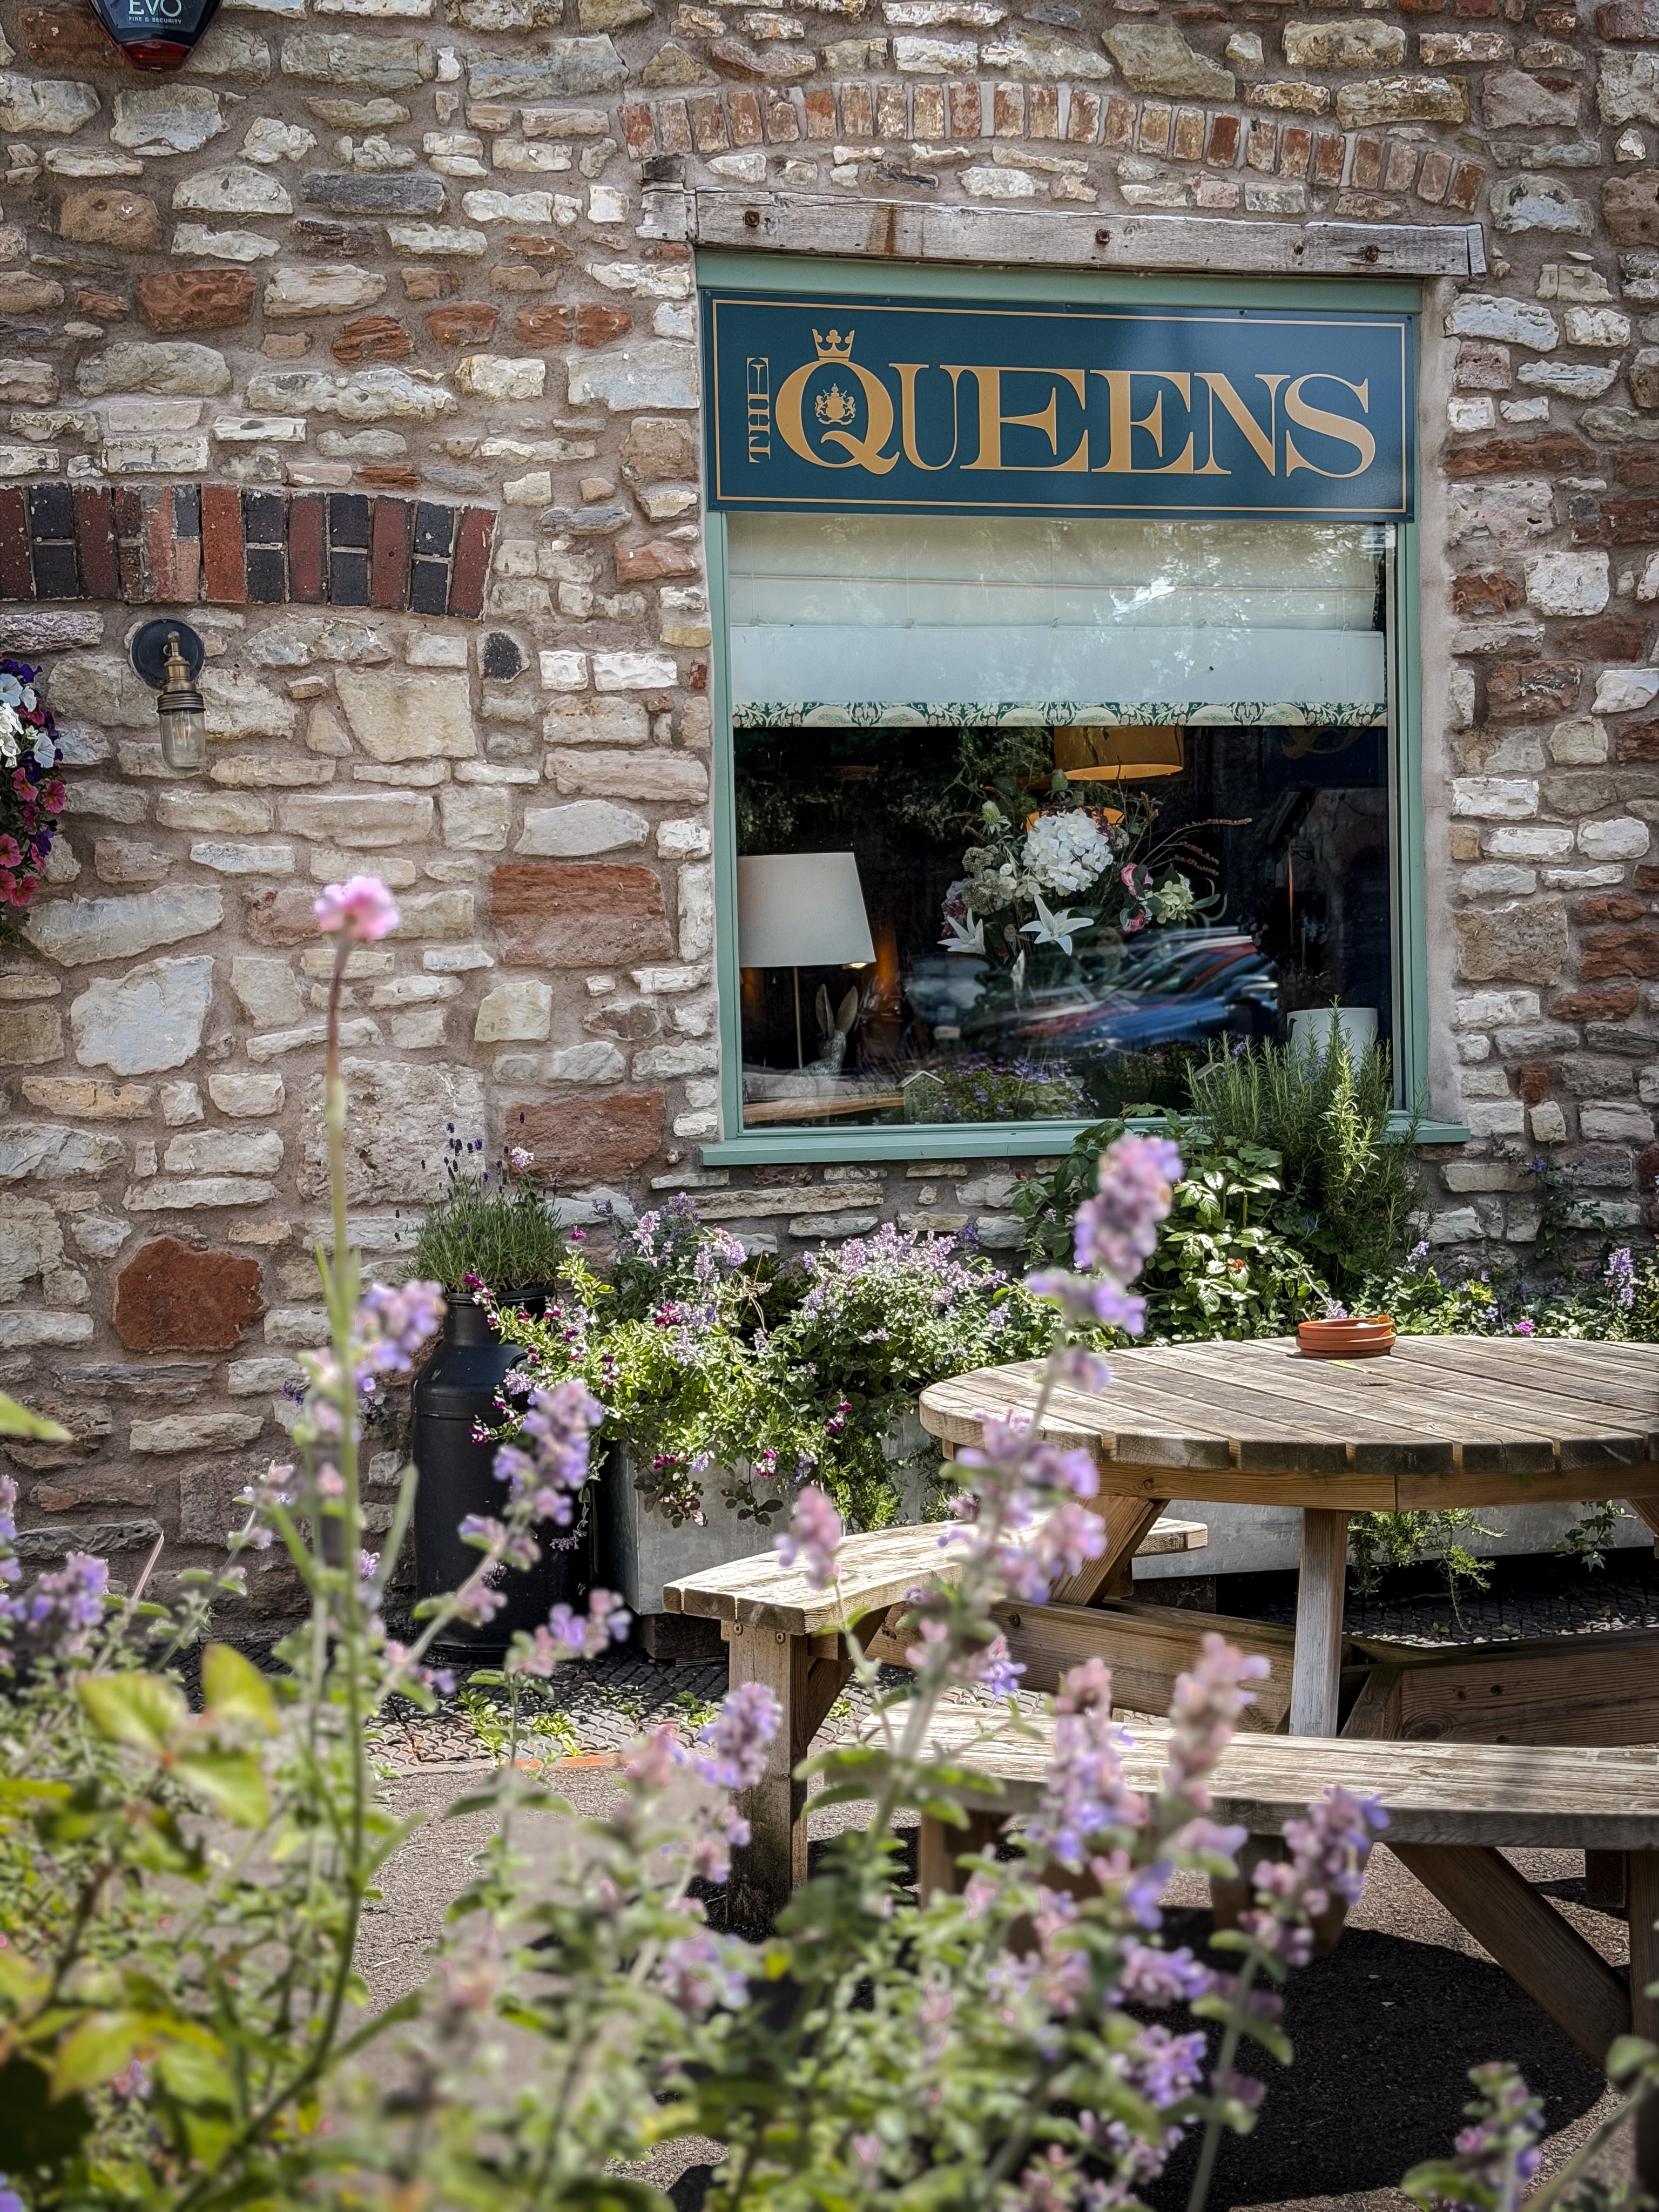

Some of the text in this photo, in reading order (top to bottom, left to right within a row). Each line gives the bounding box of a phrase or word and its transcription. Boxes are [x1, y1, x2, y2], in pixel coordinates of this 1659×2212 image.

[129, 0, 181, 17] EVO
[746, 357, 1376, 478] THE QUEENS
